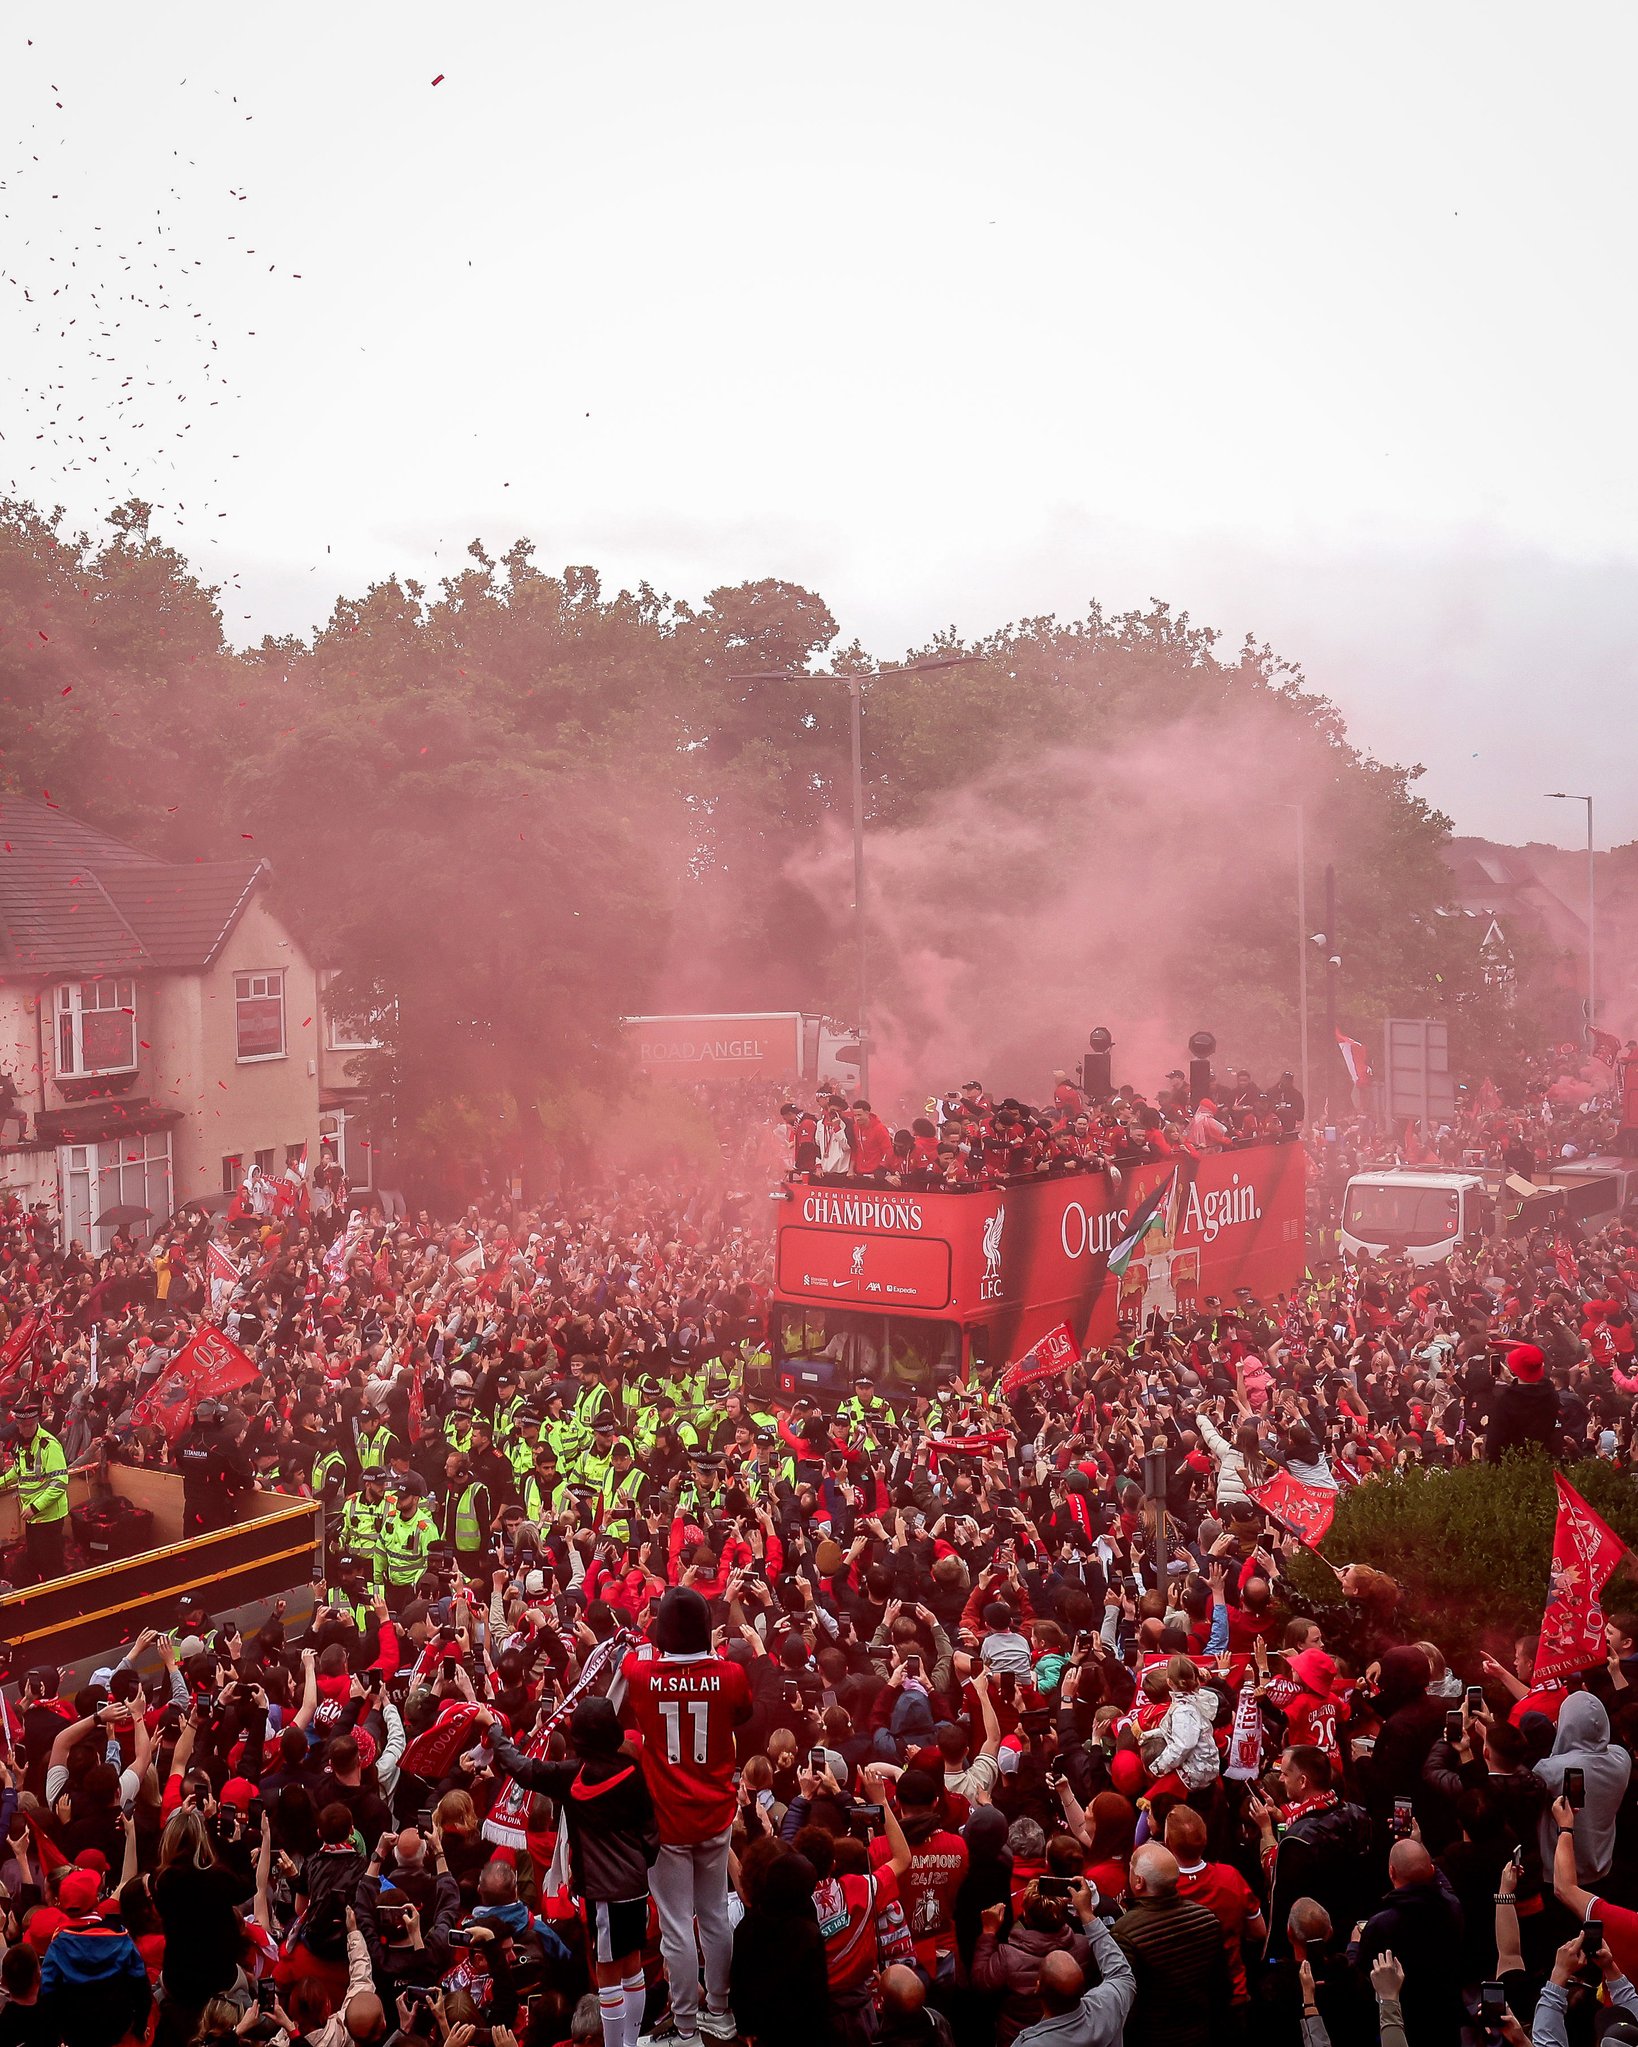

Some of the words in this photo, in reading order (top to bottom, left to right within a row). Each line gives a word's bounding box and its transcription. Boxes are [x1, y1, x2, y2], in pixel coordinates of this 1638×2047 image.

[640, 1043, 696, 1060] ROAD
[700, 1040, 763, 1060] ANGEL
[810, 1190, 859, 1201] PREMIER
[867, 1195, 914, 1205] LEAGUE
[803, 1197, 923, 1231] CHAMPIONS
[1182, 1173, 1262, 1243] Again.
[1446, 1221, 1453, 1229] 6
[865, 1282, 882, 1292] AXA
[893, 1285, 917, 1295] Expedia
[980, 1279, 1004, 1300] L.F.C.
[784, 1378, 791, 1388] 5
[1562, 1659, 1573, 1669] IN
[649, 1675, 720, 1692] M.SALAH
[658, 1701, 708, 1765] 11
[1310, 1717, 1337, 1753] 20
[495, 1812, 508, 1822] VAN
[507, 1816, 522, 1826] DIJK
[911, 1854, 962, 1870] AMPIONS
[910, 1872, 949, 1886] 24/25
